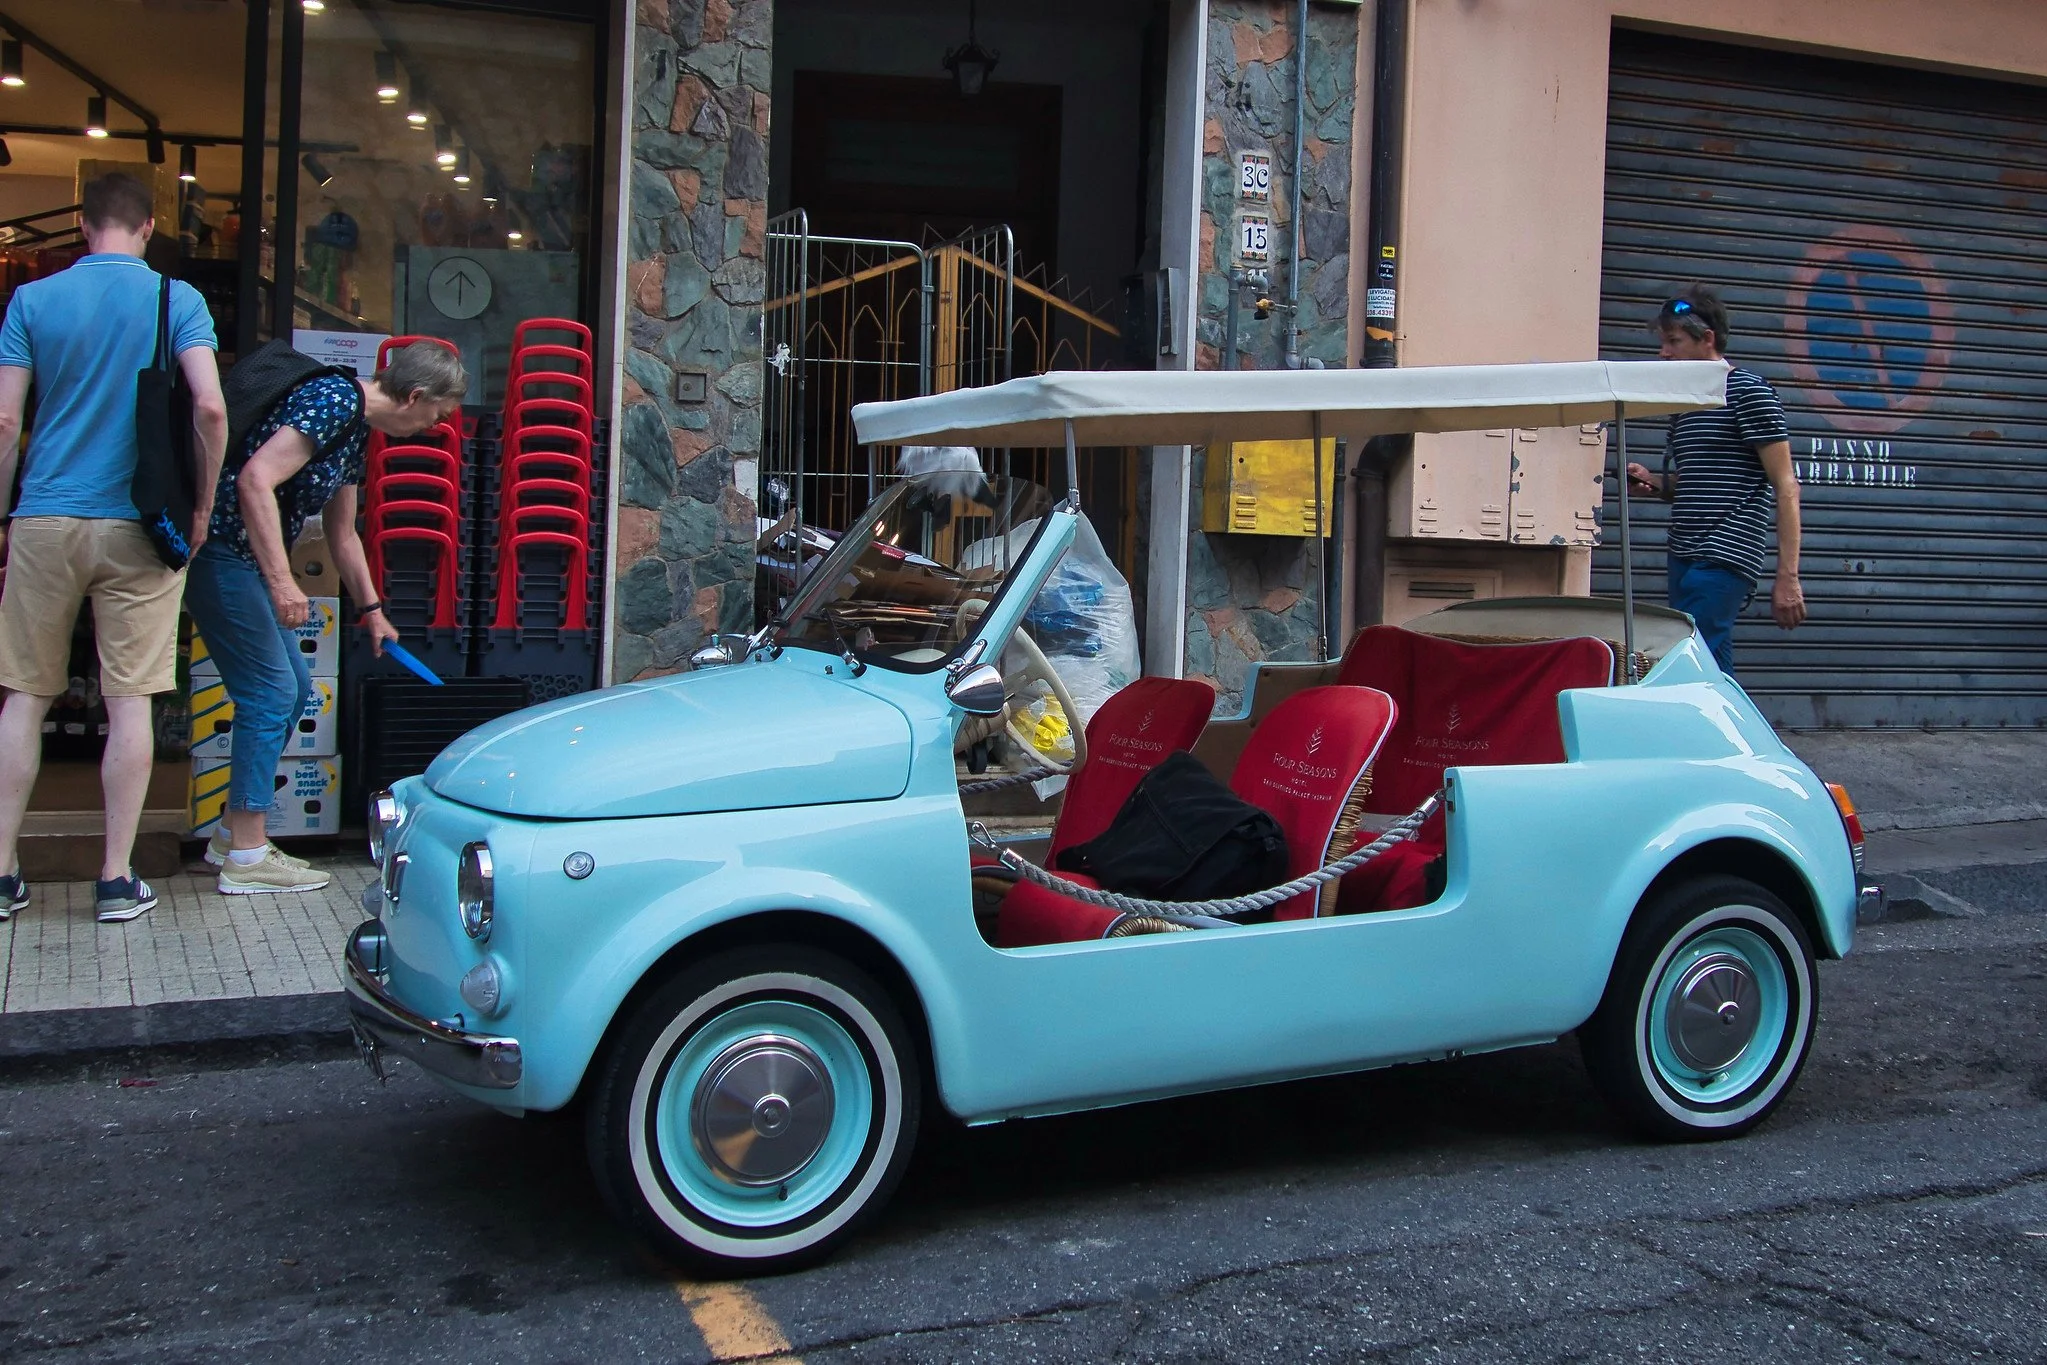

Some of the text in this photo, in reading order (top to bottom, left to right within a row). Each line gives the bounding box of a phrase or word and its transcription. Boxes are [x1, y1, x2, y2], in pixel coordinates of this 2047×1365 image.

[1244, 226, 1267, 250] 15
[1811, 437, 1890, 462] PASSO
[1794, 461, 1916, 488] ARRABILE
[304, 697, 324, 706] ack
[304, 708, 318, 716] er
[1109, 732, 1163, 752] FOUR SEASONS
[1415, 735, 1490, 751] FOUR SEASONS
[295, 769, 319, 778] best
[1273, 752, 1337, 779] FOUR SEASONS
[297, 778, 328, 787] snack
[294, 788, 322, 797] ever
